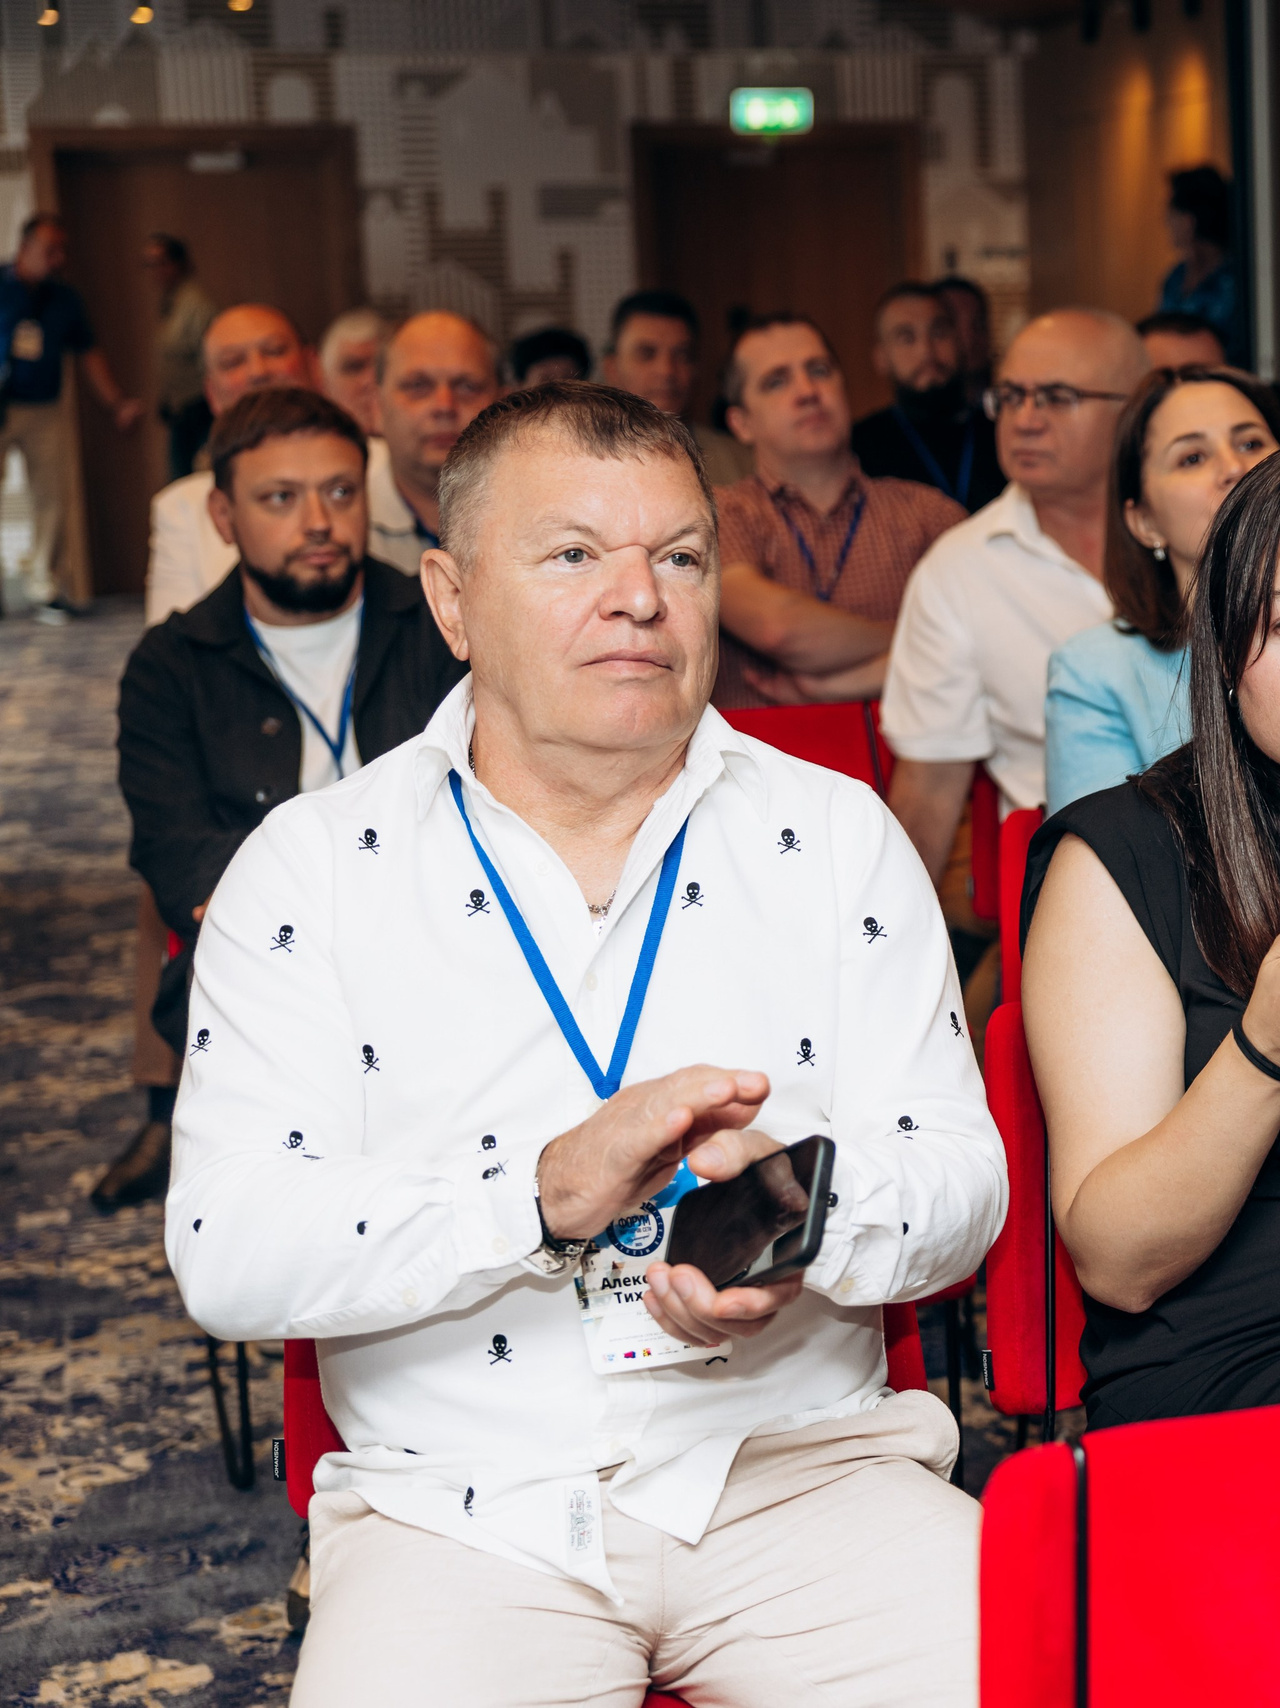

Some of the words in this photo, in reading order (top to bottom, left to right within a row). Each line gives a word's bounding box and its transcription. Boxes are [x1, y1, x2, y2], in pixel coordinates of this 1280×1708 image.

[618, 1215, 651, 1228] ФОРУМ
[601, 1274, 649, 1290] Алекс
[614, 1291, 644, 1304] Тих
